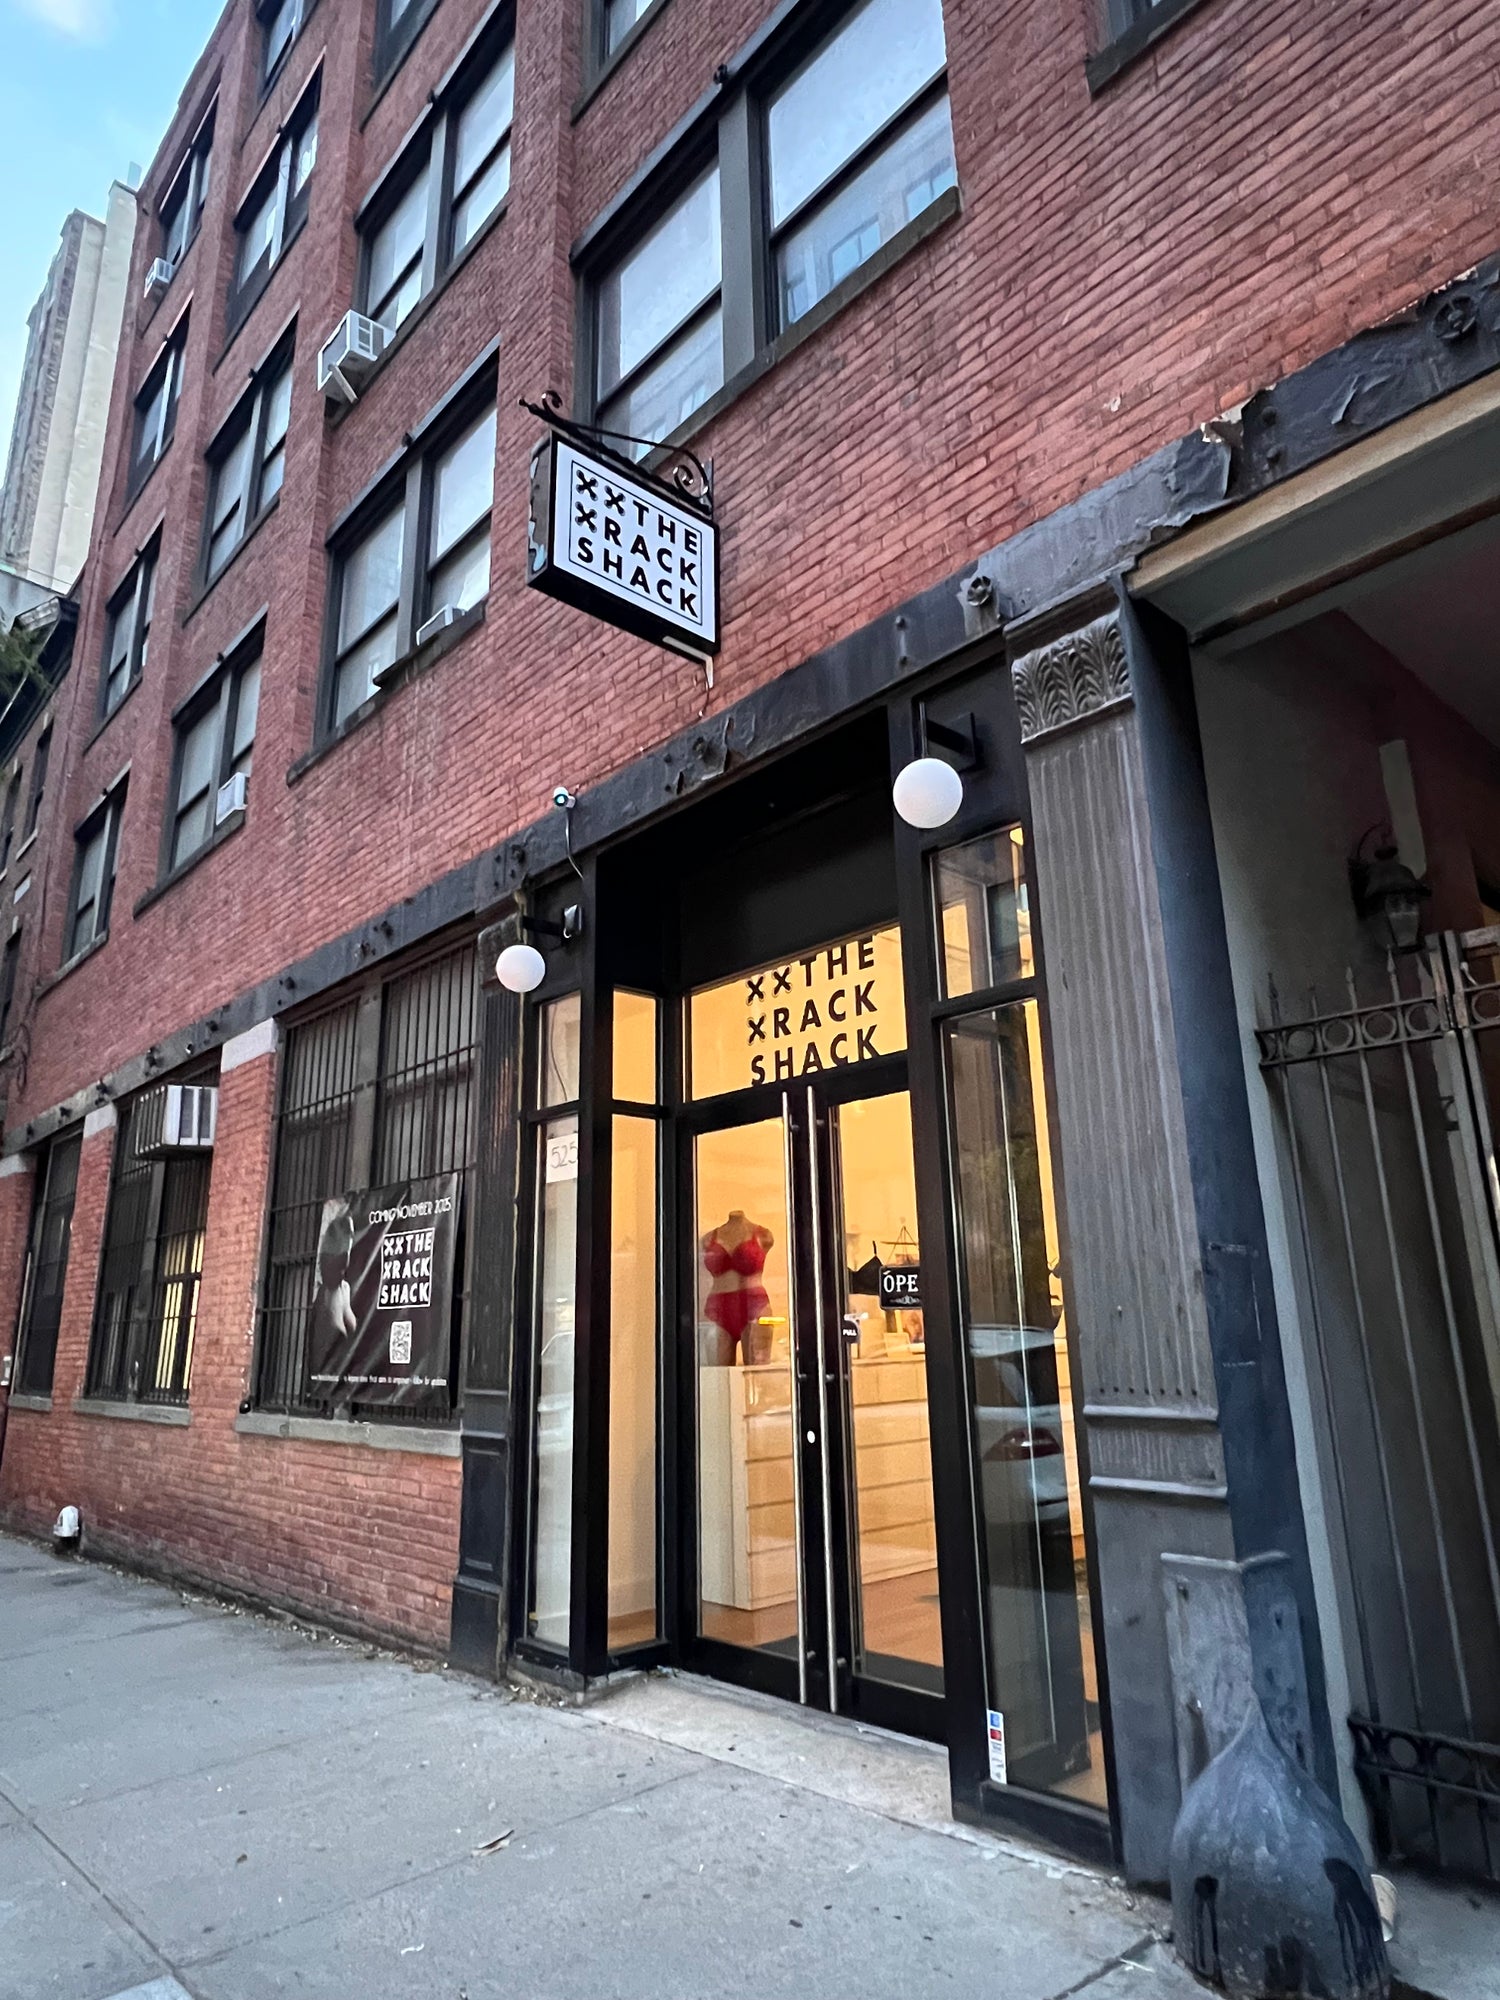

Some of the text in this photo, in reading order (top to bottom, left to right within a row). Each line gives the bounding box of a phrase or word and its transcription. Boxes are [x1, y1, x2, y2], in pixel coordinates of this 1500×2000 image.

[577, 536, 698, 618] SHACK
[751, 1024, 880, 1087] SHACK
[551, 1141, 577, 1169] 525
[380, 1282, 429, 1304] SHACK
[883, 1273, 919, 1293] OPE
[842, 1328, 857, 1337] PULL
